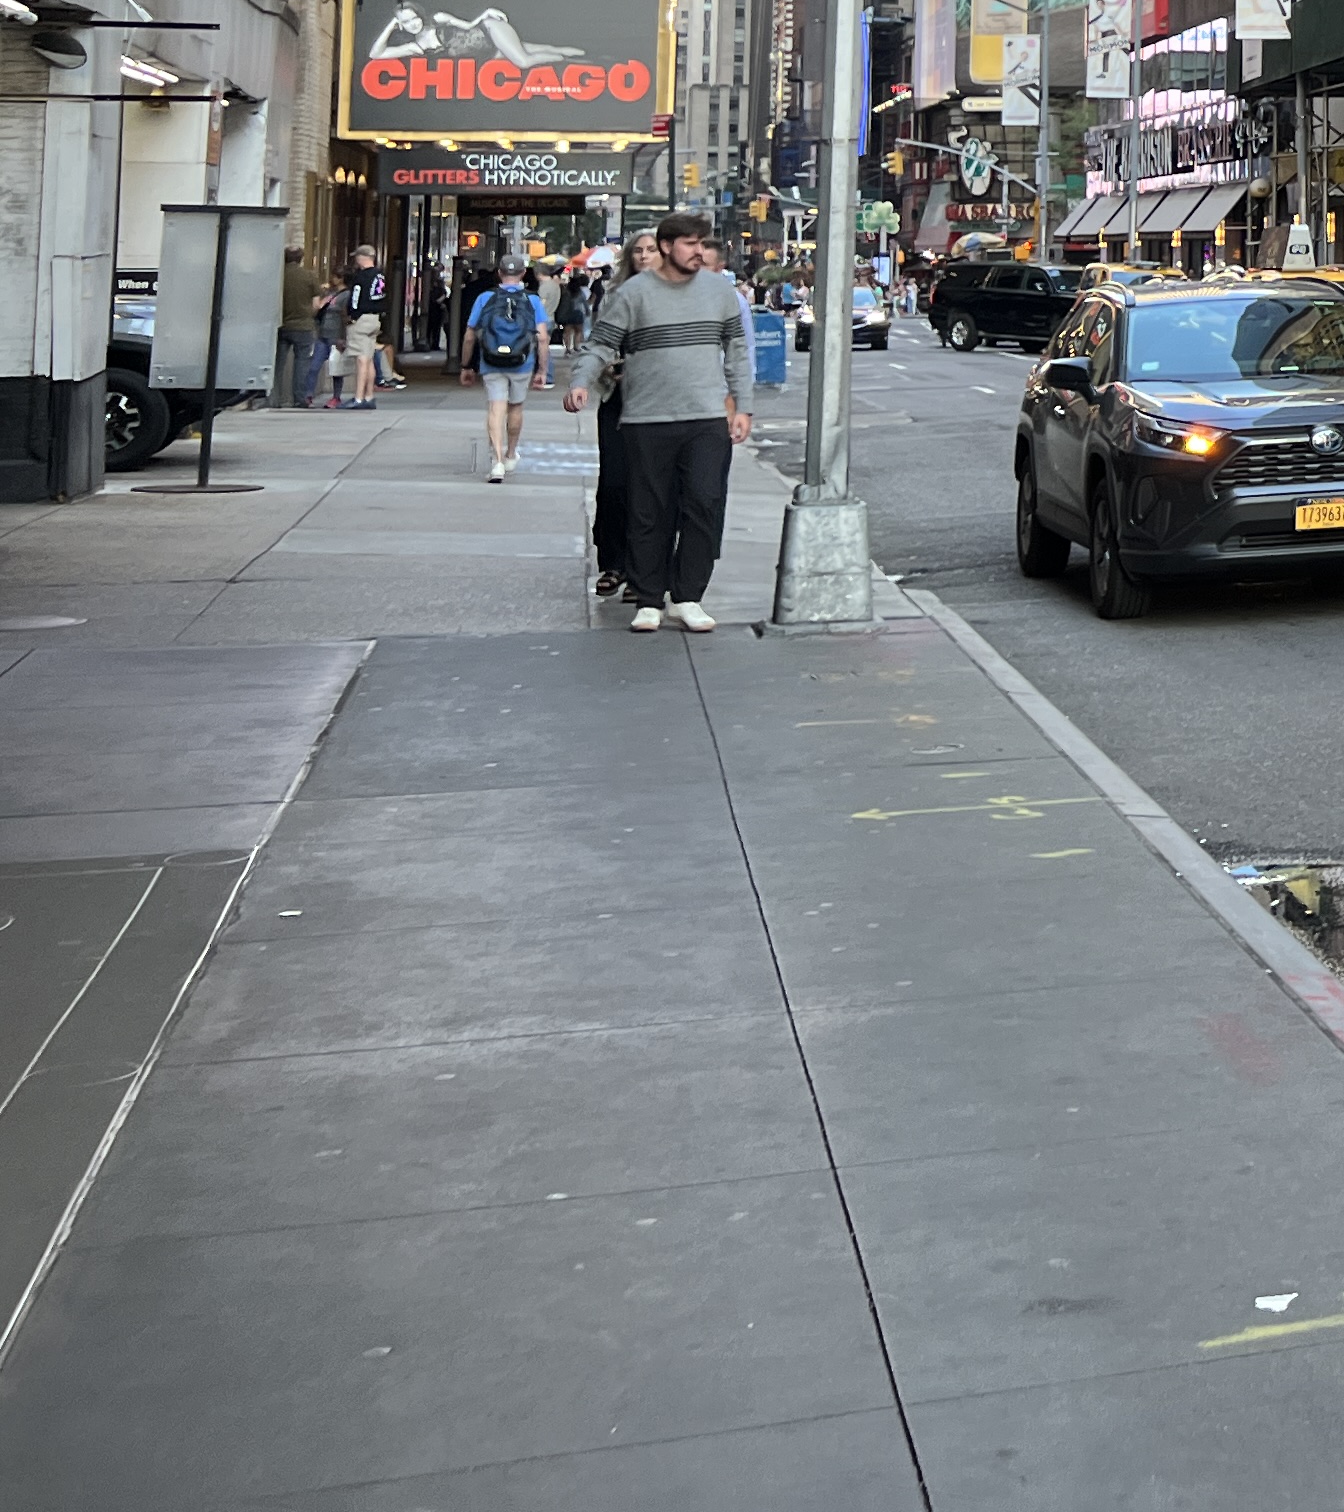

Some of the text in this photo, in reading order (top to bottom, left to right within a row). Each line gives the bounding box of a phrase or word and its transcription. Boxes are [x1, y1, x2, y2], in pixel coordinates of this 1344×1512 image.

[361, 58, 651, 102] CHICAGO
[393, 169, 480, 186] GLITTERS
[117, 279, 149, 289] When
